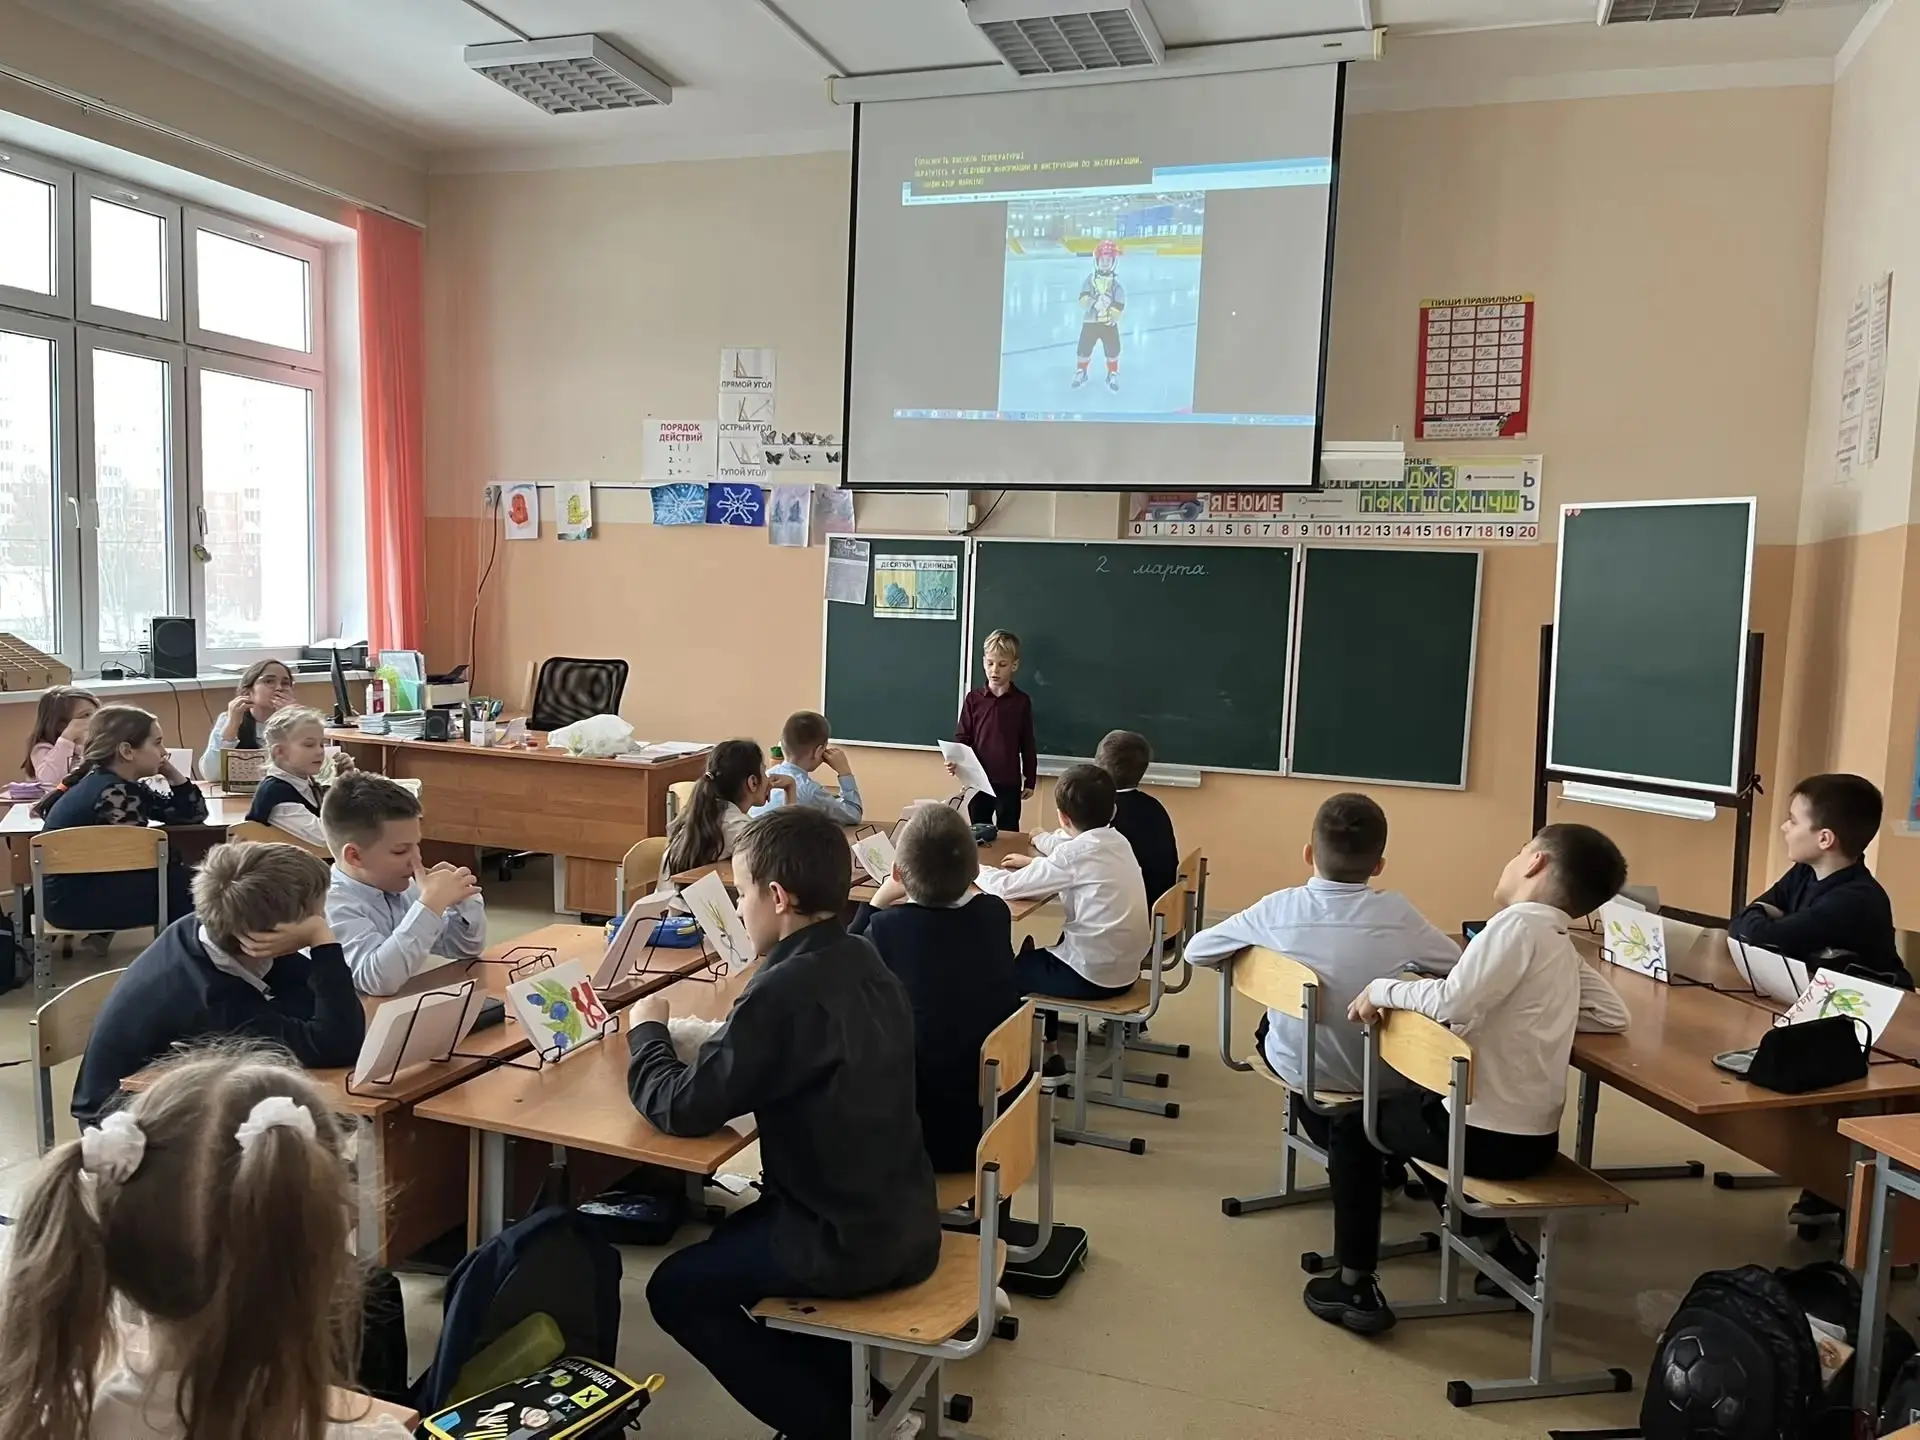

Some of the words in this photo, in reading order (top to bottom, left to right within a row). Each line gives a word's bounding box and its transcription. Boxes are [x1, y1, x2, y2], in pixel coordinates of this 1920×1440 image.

[1431, 299, 1461, 307] ПИШИ
[1463, 295, 1522, 305] ПРАВИЛЬНО
[721, 380, 752, 389] ПРЯМОЙ
[753, 381, 772, 389] УГОЛ
[660, 423, 700, 432] ПОРЯДОК
[719, 423, 751, 431] ОСТРЫЙ
[752, 424, 772, 432] УГОЛ
[658, 432, 703, 443] ДЕЙСТВИЙ
[720, 467, 746, 476] ТУПОЙ
[747, 468, 767, 476] УГОЛ
[1134, 523, 1142, 535] 0
[1152, 523, 1159, 534] 1
[1170, 523, 1178, 535] 2
[1188, 523, 1196, 535] 3
[1206, 524, 1214, 535] 4
[1225, 523, 1233, 535] 5
[1244, 524, 1252, 535] 6
[1263, 524, 1271, 535] 7
[1281, 524, 1290, 536] 8
[1300, 524, 1309, 536] 9
[1317, 525, 1332, 536] 10
[1337, 525, 1351, 536] 11
[1355, 525, 1371, 537] 12
[1375, 525, 1391, 537] 13
[1395, 525, 1411, 537] 14
[1415, 525, 1432, 537] 15
[1436, 525, 1452, 537] 16
[1456, 525, 1473, 537] 17
[1477, 525, 1493, 537] 18
[1498, 525, 1514, 537] 19
[1519, 525, 1537, 537] 20
[880, 561, 912, 569] ДЕСЯТКИ
[918, 561, 954, 570] ЕДИНИЦЫ
[1095, 555, 1110, 573] 2
[579, 1367, 617, 1389] БУМАГА
